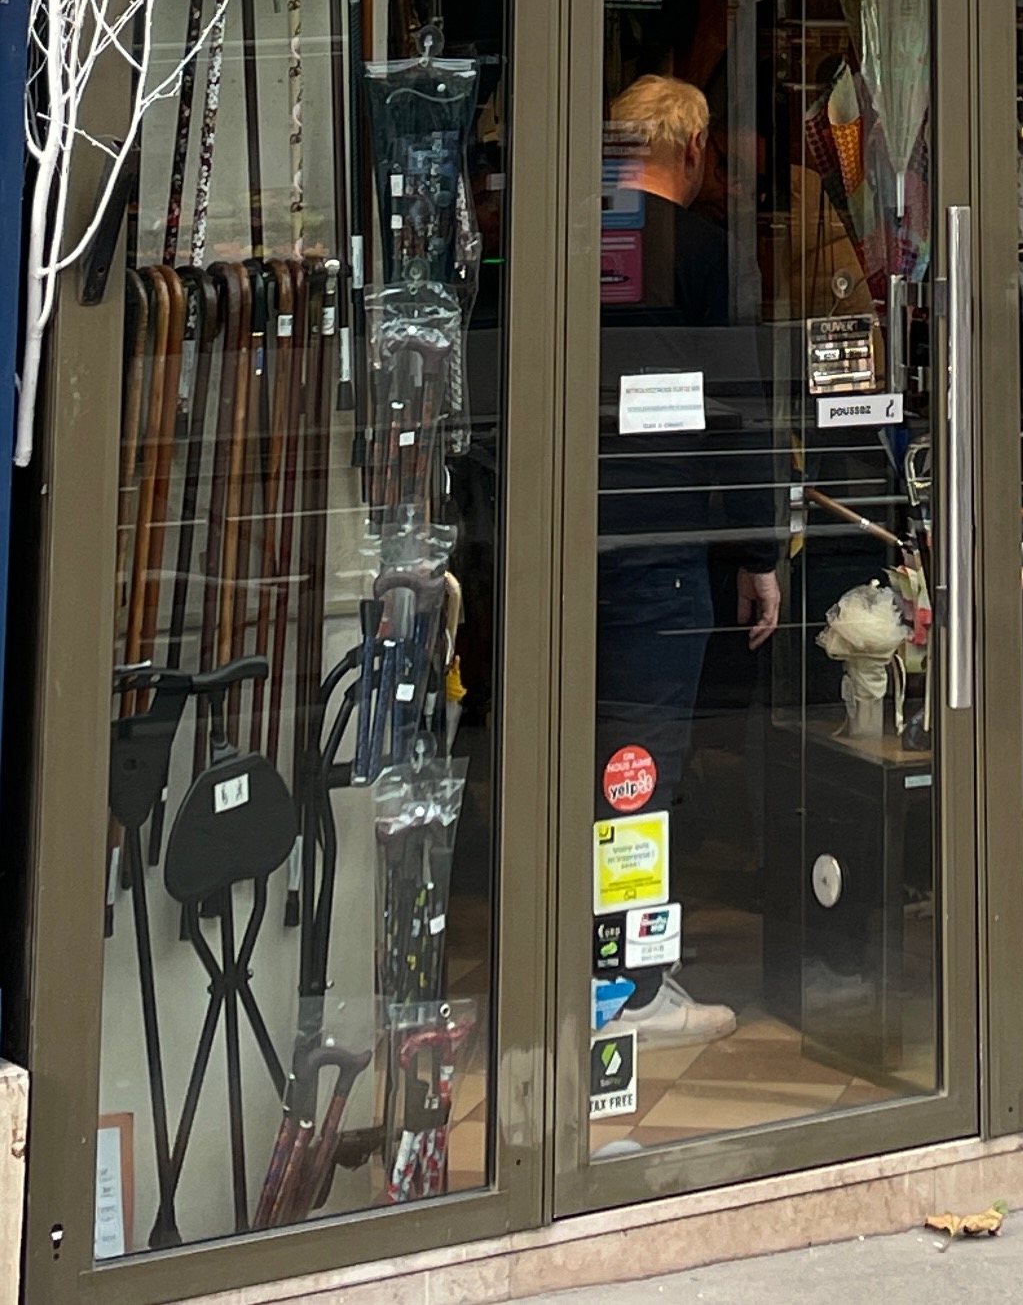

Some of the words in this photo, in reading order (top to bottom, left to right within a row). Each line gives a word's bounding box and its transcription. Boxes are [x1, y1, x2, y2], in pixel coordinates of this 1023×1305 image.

[830, 406, 871, 419] poussez
[610, 781, 638, 800] yelp
[609, 1094, 633, 1110] FREE
